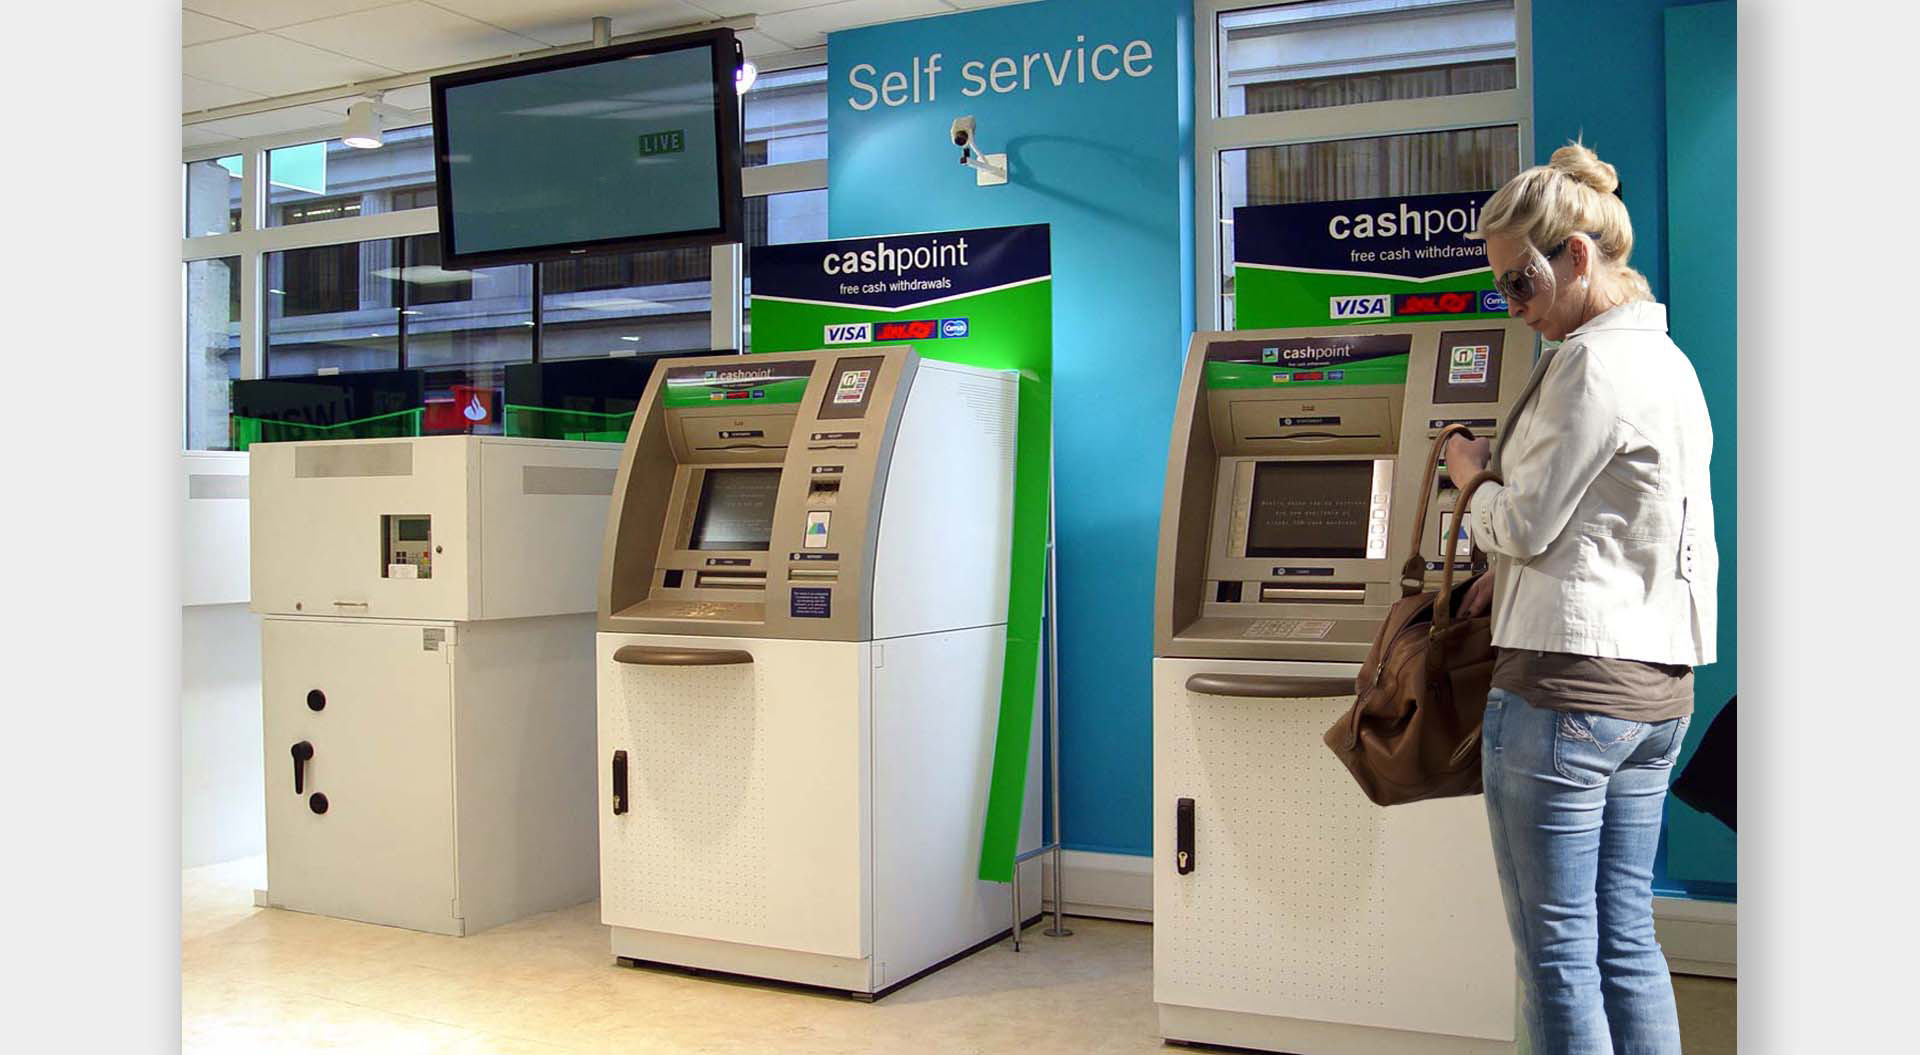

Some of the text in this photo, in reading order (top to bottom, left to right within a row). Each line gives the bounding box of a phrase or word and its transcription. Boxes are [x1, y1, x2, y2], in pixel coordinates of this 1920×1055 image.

[848, 35, 1153, 111] Self service
[644, 133, 680, 152] LIVE
[1328, 200, 1476, 241] cashpoi
[822, 237, 968, 276] cashpoint
[1350, 242, 1487, 262] free cash withdrawal
[839, 277, 951, 295] free cash withdrawals
[1336, 298, 1385, 315] VISA
[829, 326, 867, 341] VISA
[1283, 344, 1350, 360] cashpoint
